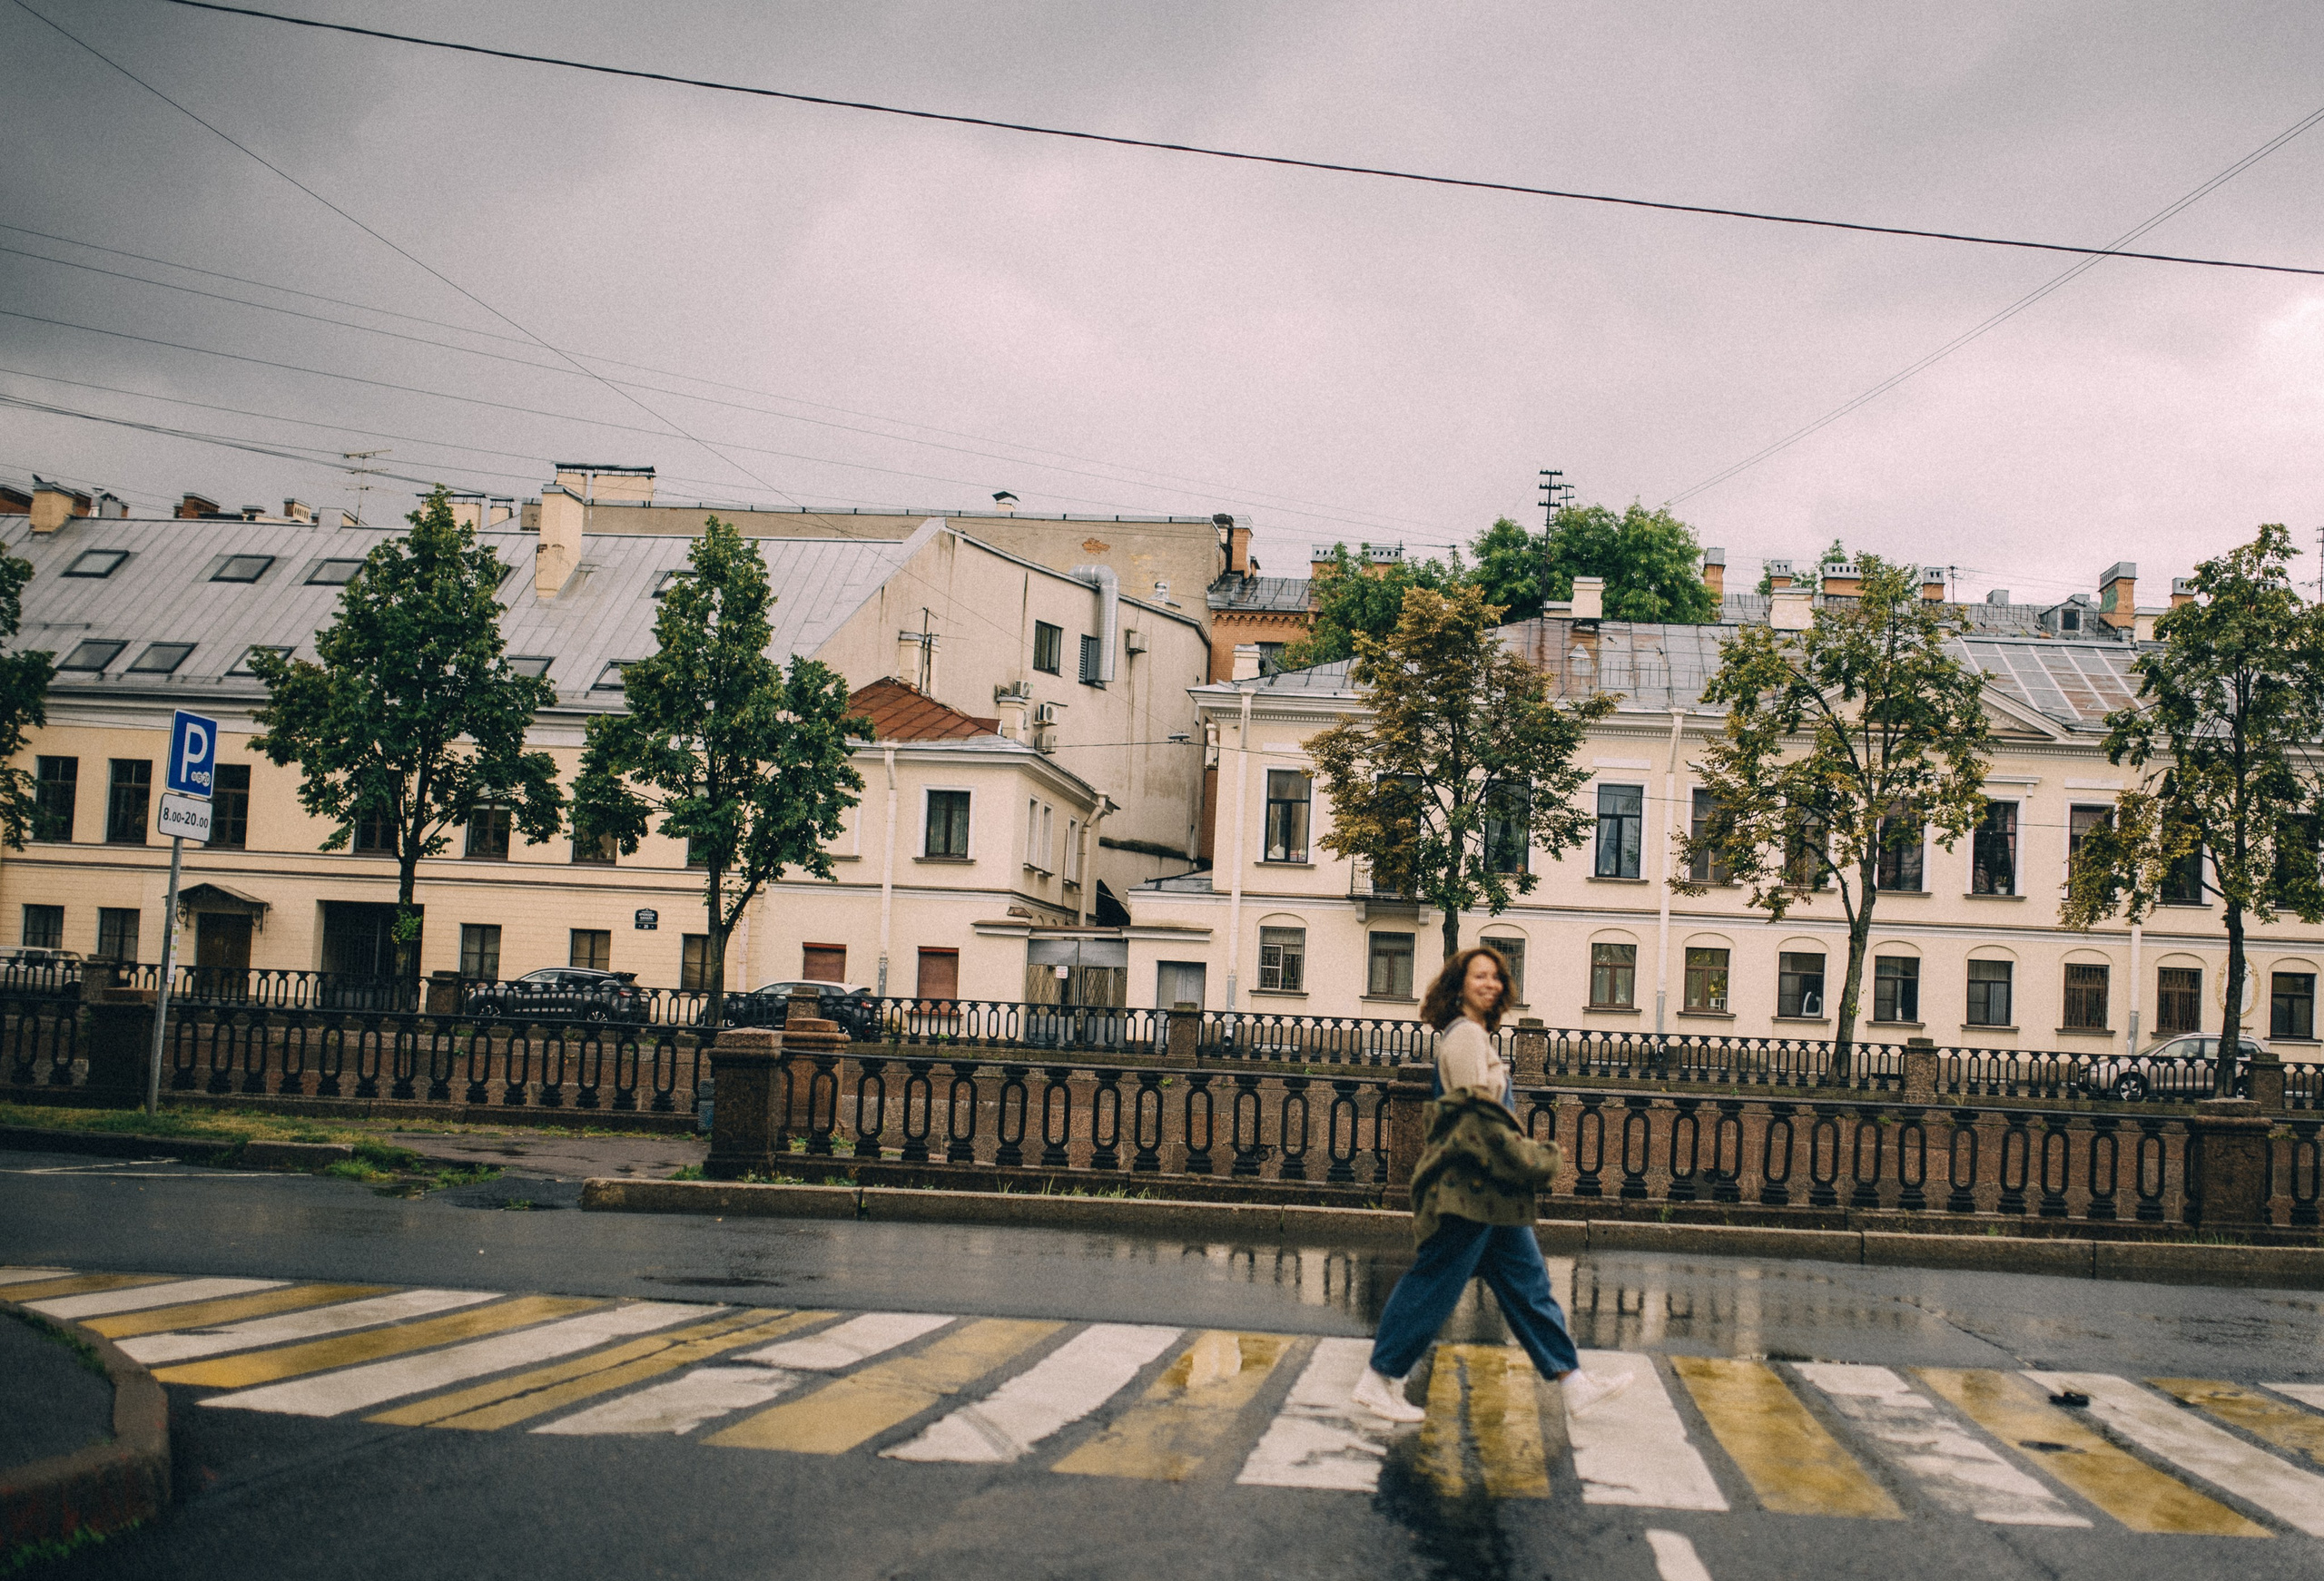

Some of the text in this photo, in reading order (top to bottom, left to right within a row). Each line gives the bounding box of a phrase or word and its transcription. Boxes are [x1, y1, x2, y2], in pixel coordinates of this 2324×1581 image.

[181, 722, 208, 783] P
[197, 773, 202, 781] 15
[203, 774, 210, 783] 20
[163, 807, 209, 828] 8.00-20.00
